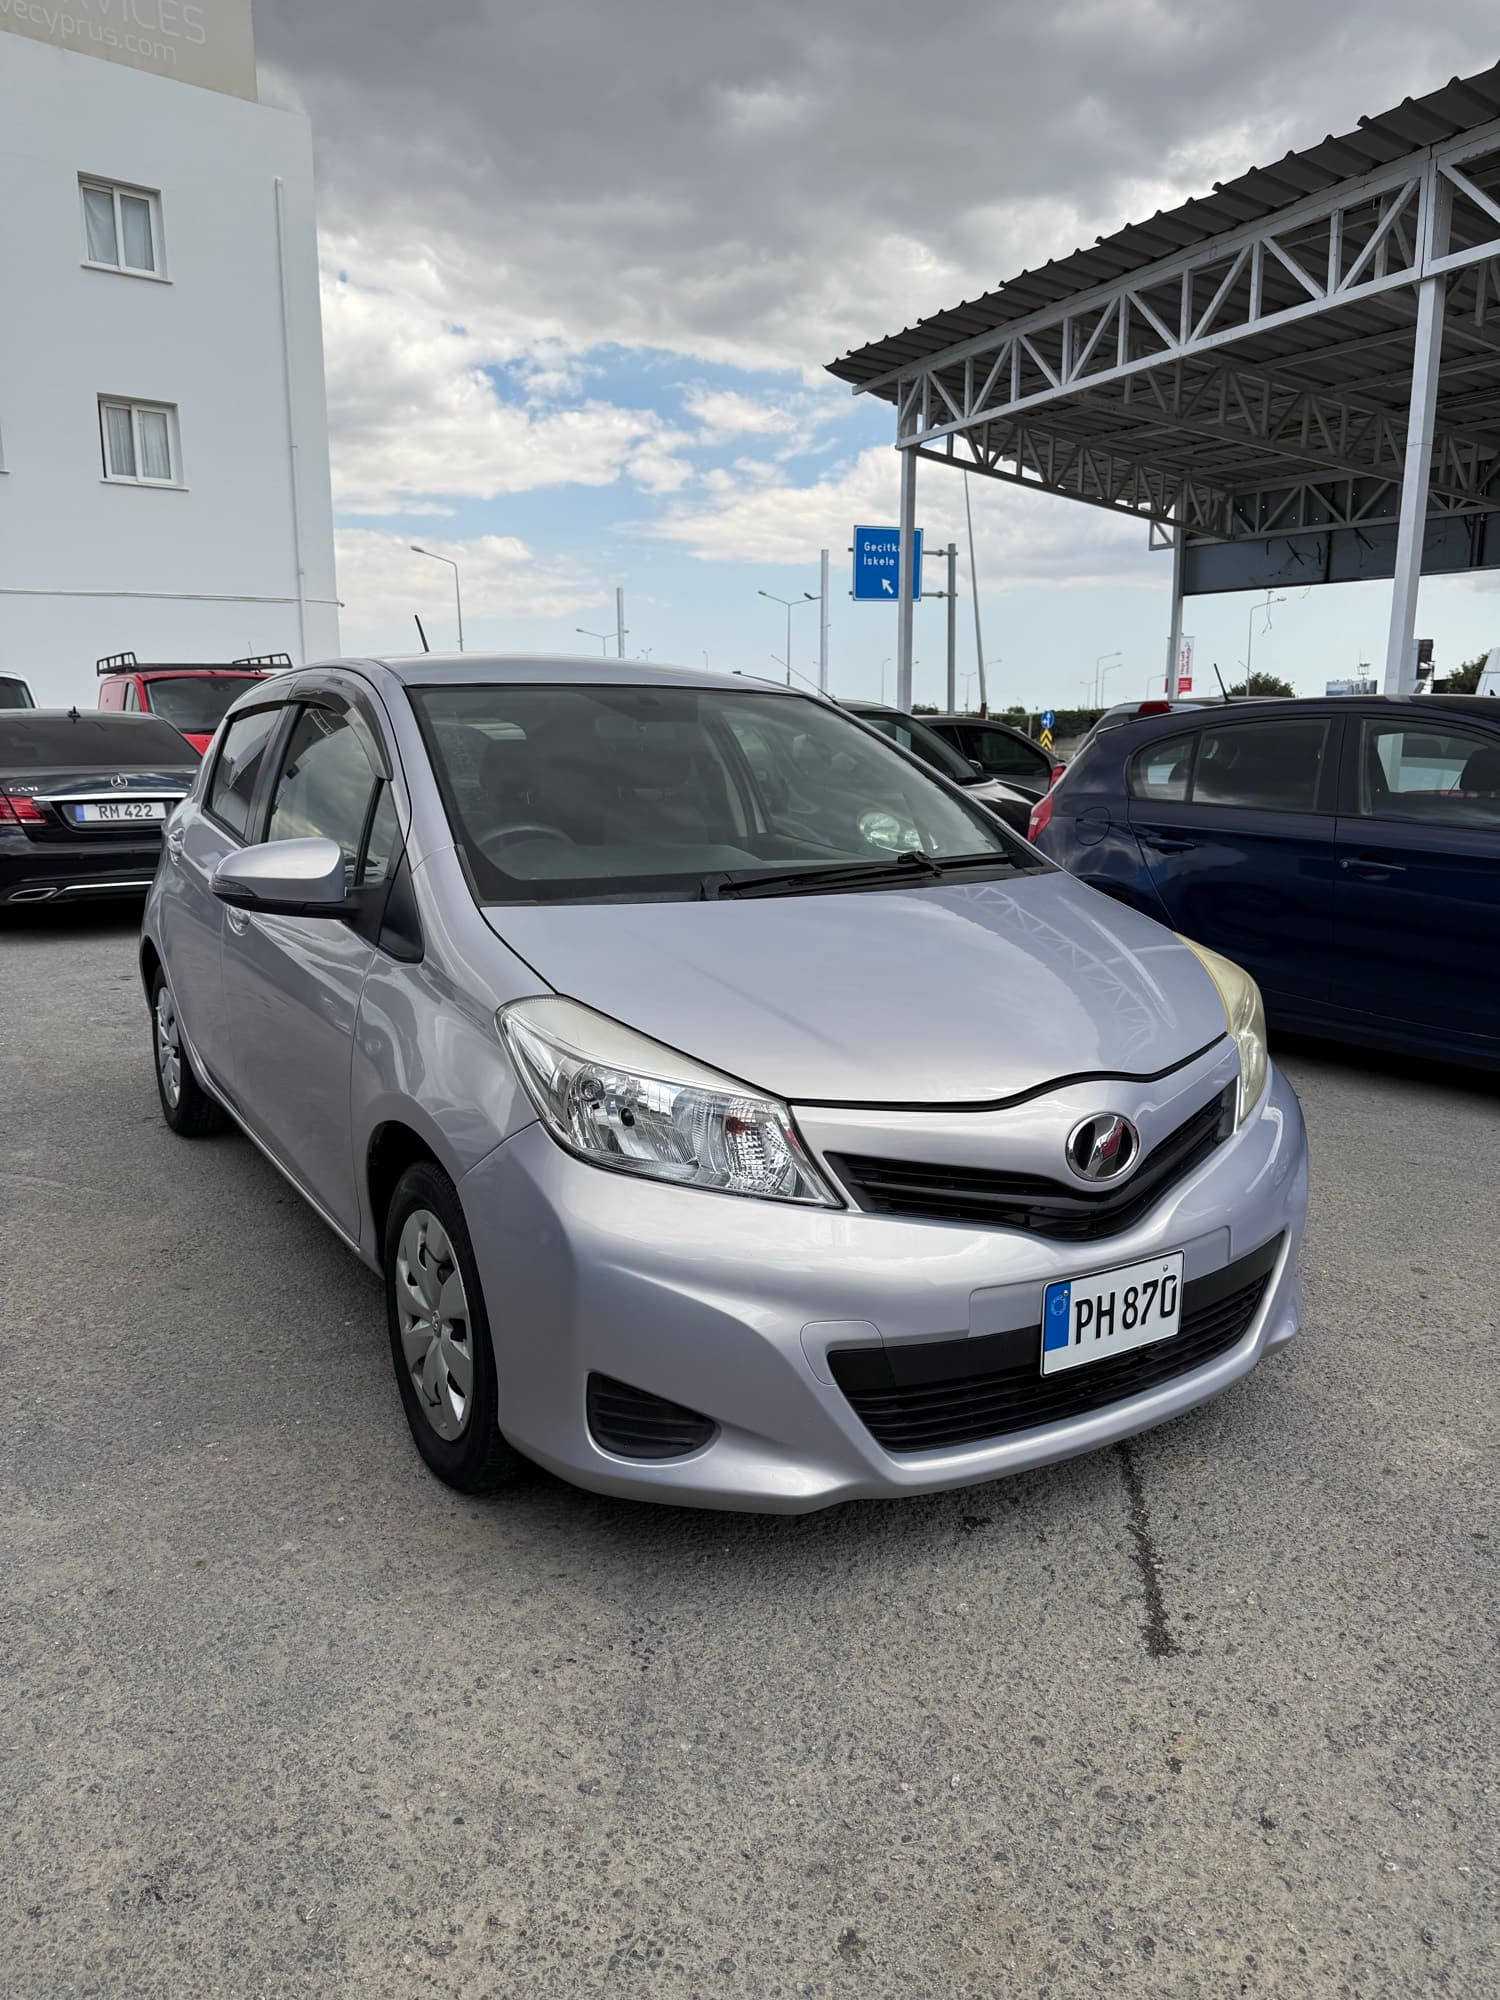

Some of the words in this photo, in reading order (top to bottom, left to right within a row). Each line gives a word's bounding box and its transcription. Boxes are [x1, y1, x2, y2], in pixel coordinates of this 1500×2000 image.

[62, 0, 206, 45] ICES
[99, 804, 121, 819] RM
[124, 804, 153, 818] 422
[1074, 1291, 1116, 1345] PH
[1121, 1274, 1178, 1330] 870
